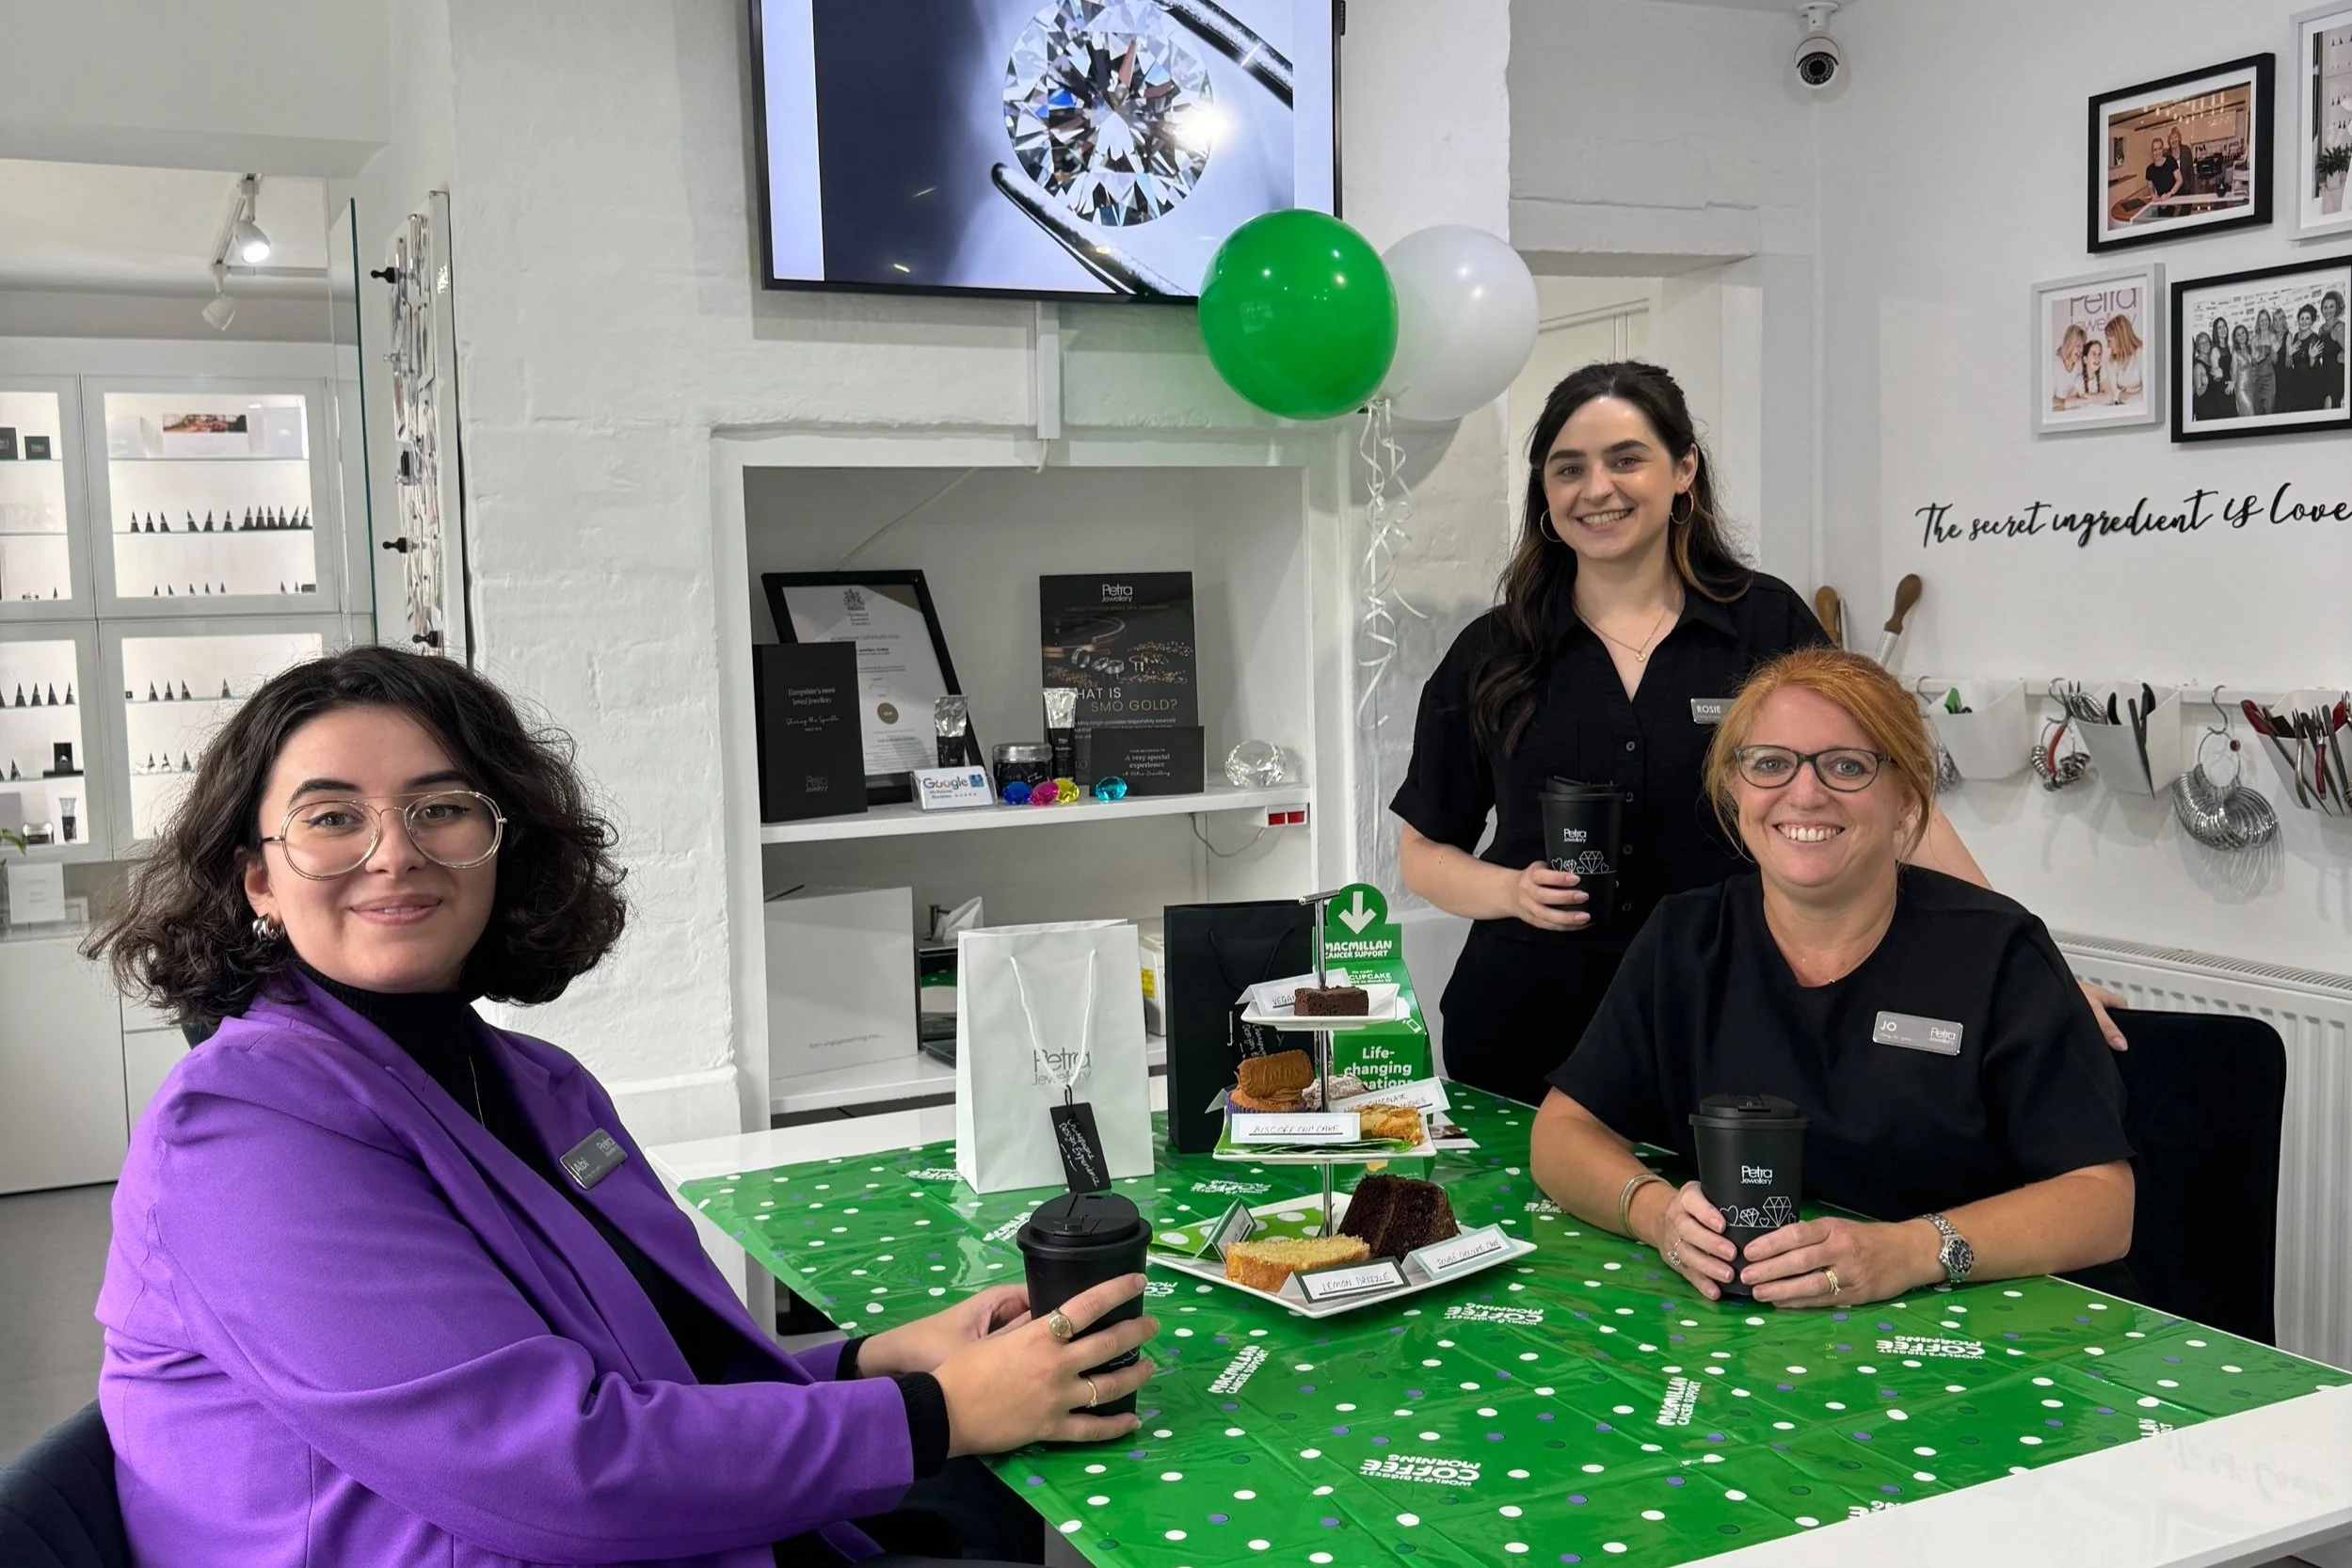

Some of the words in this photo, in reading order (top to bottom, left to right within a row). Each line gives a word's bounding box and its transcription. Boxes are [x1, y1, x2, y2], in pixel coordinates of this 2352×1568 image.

[1915, 503, 1962, 548] The
[1968, 501, 2052, 542] secret
[2053, 488, 2218, 548] ingredient
[2223, 494, 2264, 528] is
[1102, 584, 1133, 597] Petra
[1076, 687, 1104, 700] HAT
[1109, 687, 1122, 698] IS
[1092, 700, 1124, 712] SMO
[1129, 699, 1177, 712] GOLD?
[1696, 705, 1721, 713] ROSIE
[1147, 753, 1171, 761] special
[923, 776, 968, 790] Google
[1563, 828, 1587, 839] Petra
[1324, 940, 1393, 952] MACMILLAN
[1324, 951, 1353, 959] CANCER
[1353, 950, 1389, 958] SUPPORT
[1349, 972, 1392, 981] CUPCAKE
[1880, 1020, 1897, 1032] JO
[1930, 1026, 1957, 1041] Petra
[1033, 1047, 1092, 1073] Petra
[1362, 1046, 1395, 1061] Life-
[1344, 1061, 1413, 1078] changing
[1741, 1165, 1773, 1178] Petra
[1741, 1177, 1773, 1186] Jewellery
[1321, 1280, 1352, 1291] LEMON
[1355, 1272, 1390, 1286] DRIZZLE
[1445, 1306, 1544, 1322] COFFEE
[1465, 1303, 1544, 1315] MORNING
[1876, 1339, 1986, 1356] COFFEE
[1895, 1336, 1982, 1347] MORNING
[1243, 1349, 1270, 1373] SUPPORT
[1387, 1453, 1481, 1469] MORNING
[1358, 1470, 1413, 1481] BIGGEST
[1359, 1459, 1480, 1481] COFFEE
[1413, 1476, 1472, 1487] WORLD'S
